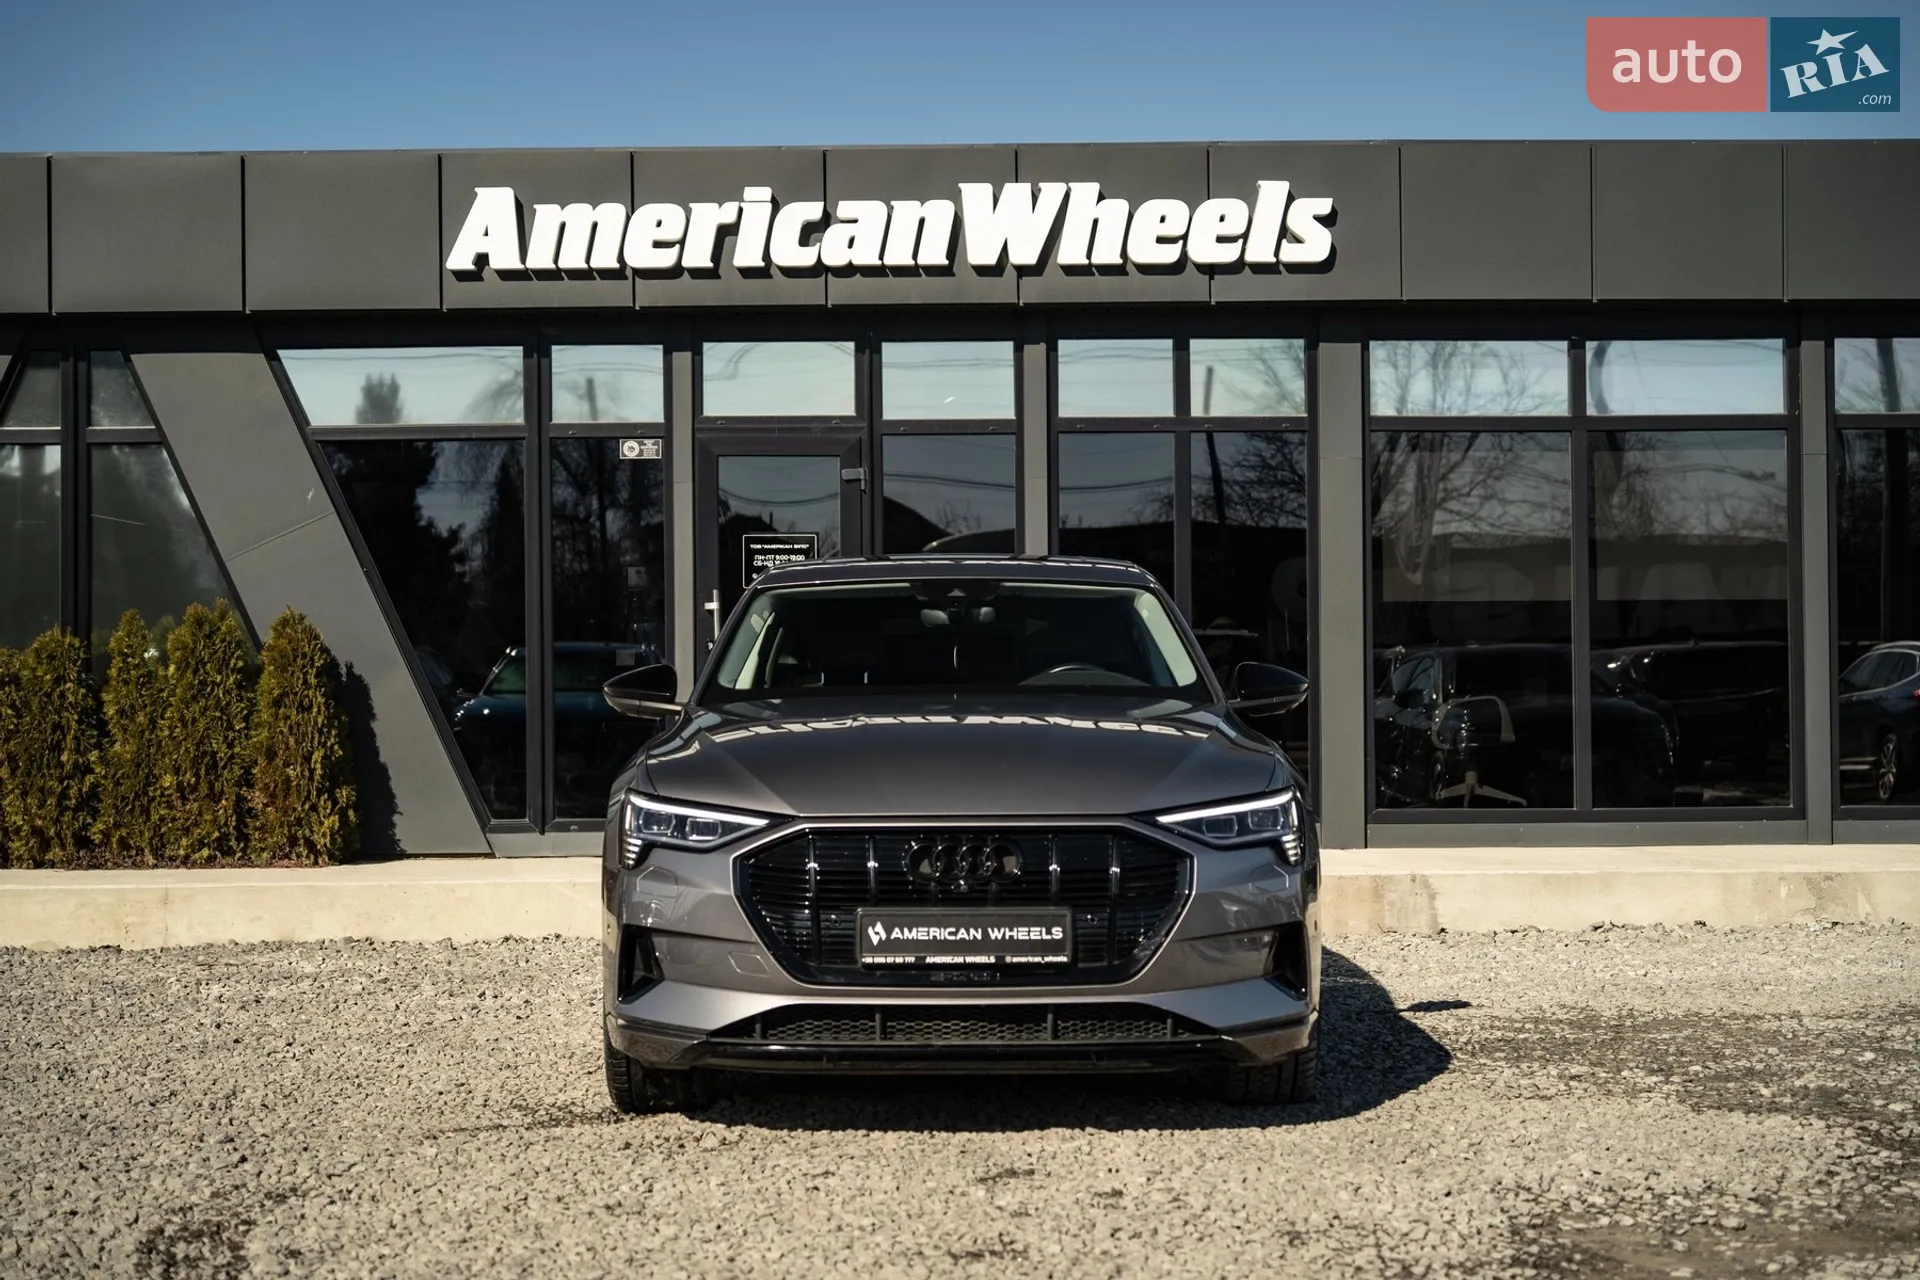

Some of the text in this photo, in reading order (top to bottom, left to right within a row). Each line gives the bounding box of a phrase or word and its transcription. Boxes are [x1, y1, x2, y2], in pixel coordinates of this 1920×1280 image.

[446, 180, 1334, 272] AmericanWheels
[890, 926, 1064, 941] AMERICAN WHEELS
[925, 956, 996, 964] AMERICAN WHEELS
